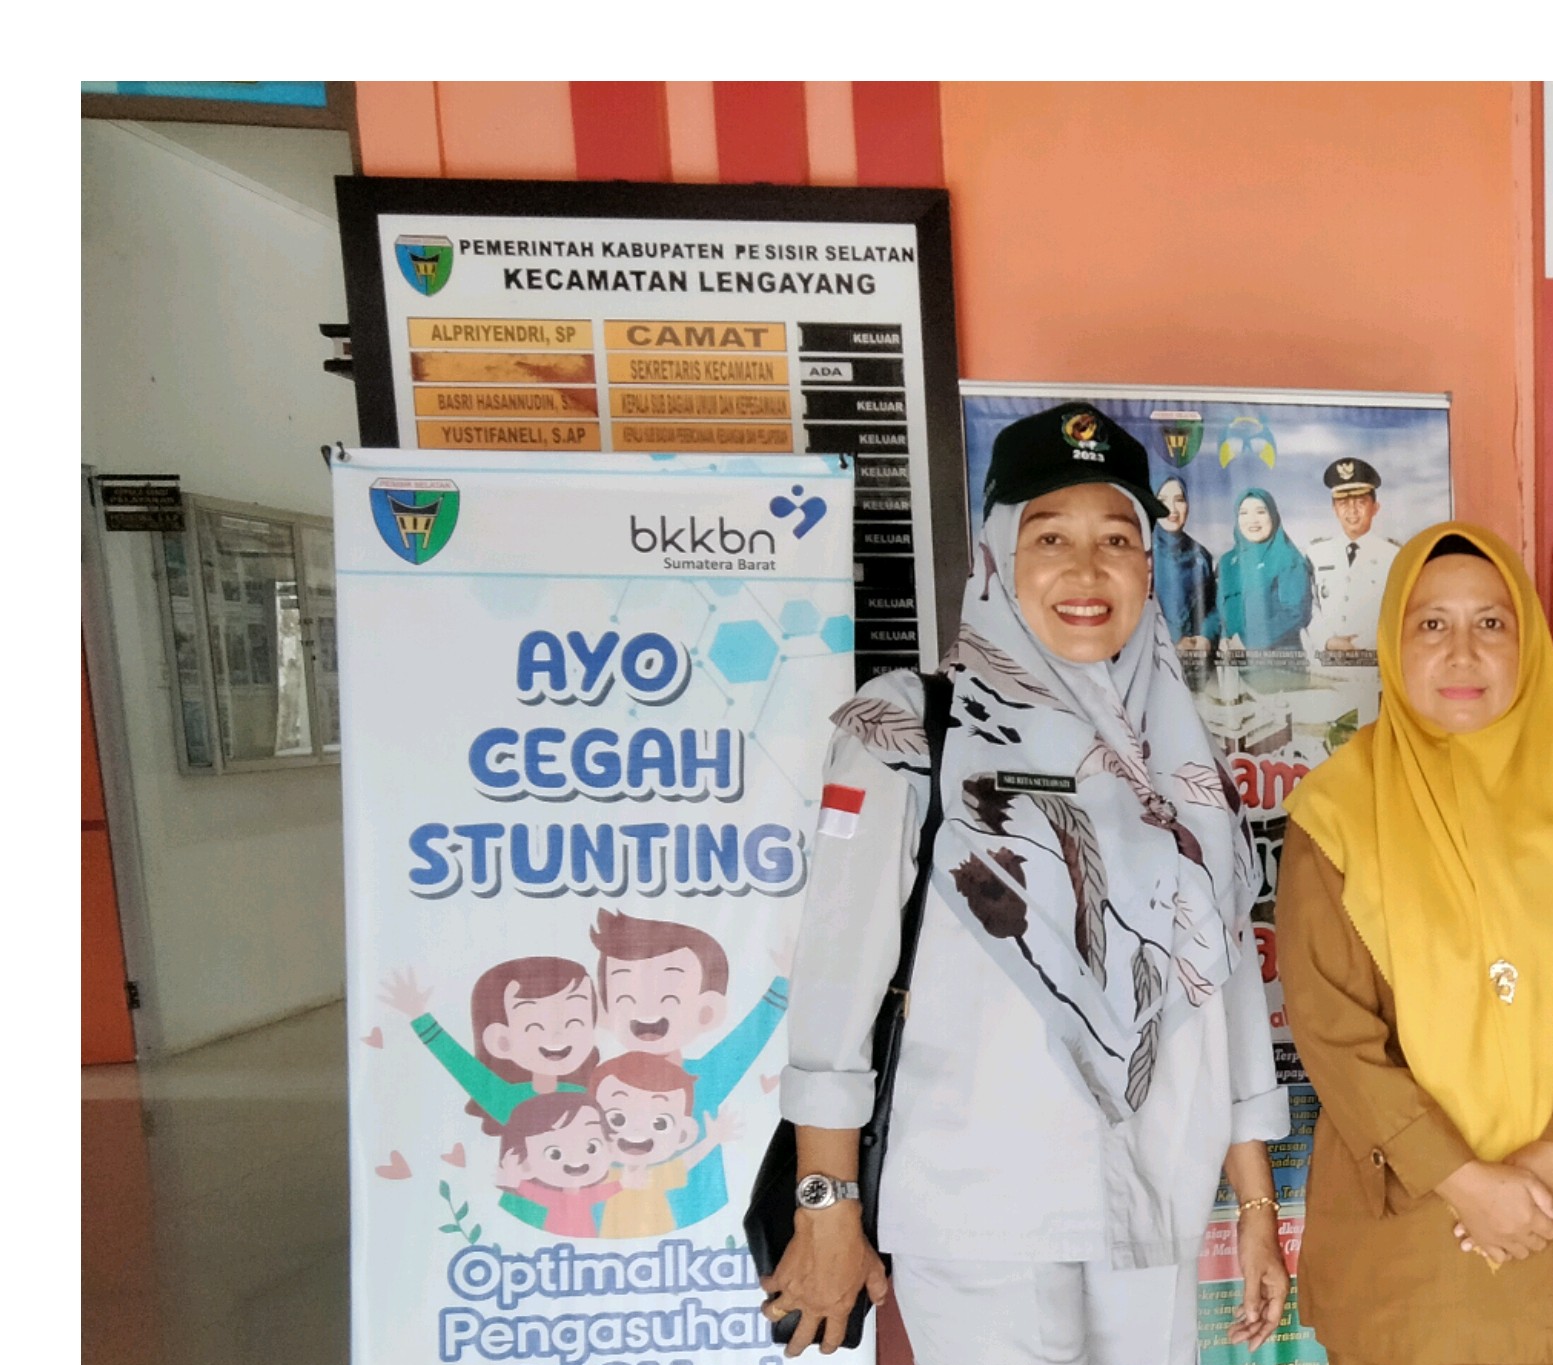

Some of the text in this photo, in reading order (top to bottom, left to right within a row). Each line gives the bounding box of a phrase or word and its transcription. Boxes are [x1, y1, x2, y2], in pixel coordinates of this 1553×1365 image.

[459, 239, 594, 258] PEMERINTAH
[602, 241, 724, 260] KABUPATEN
[825, 246, 915, 263] SELATAN
[503, 267, 877, 296] KECAMATAN LENGAYANG
[430, 324, 576, 345] ALPRIYENDRI, SP
[626, 324, 769, 348] CAMAT
[853, 333, 901, 345] KELUAR
[630, 359, 774, 383] SEKRETARIS KECAMATAN
[809, 366, 843, 377] ADA
[437, 394, 474, 411] BASRI
[857, 401, 904, 412] KELUAR
[441, 426, 587, 445] YUSTIFANELI, S.AP
[858, 434, 906, 445] KELUAR
[860, 467, 908, 478] KELUAR
[862, 500, 910, 512] KELUAR
[629, 515, 777, 556] bkkbn
[864, 533, 911, 544] KELUAR
[663, 557, 777, 571] Sumatera Barat
[868, 598, 915, 609] KELUAR
[870, 630, 917, 641] KELUAR
[514, 630, 690, 704] AYO
[467, 727, 741, 800] CEGAH
[406, 822, 806, 896] STUNTING
